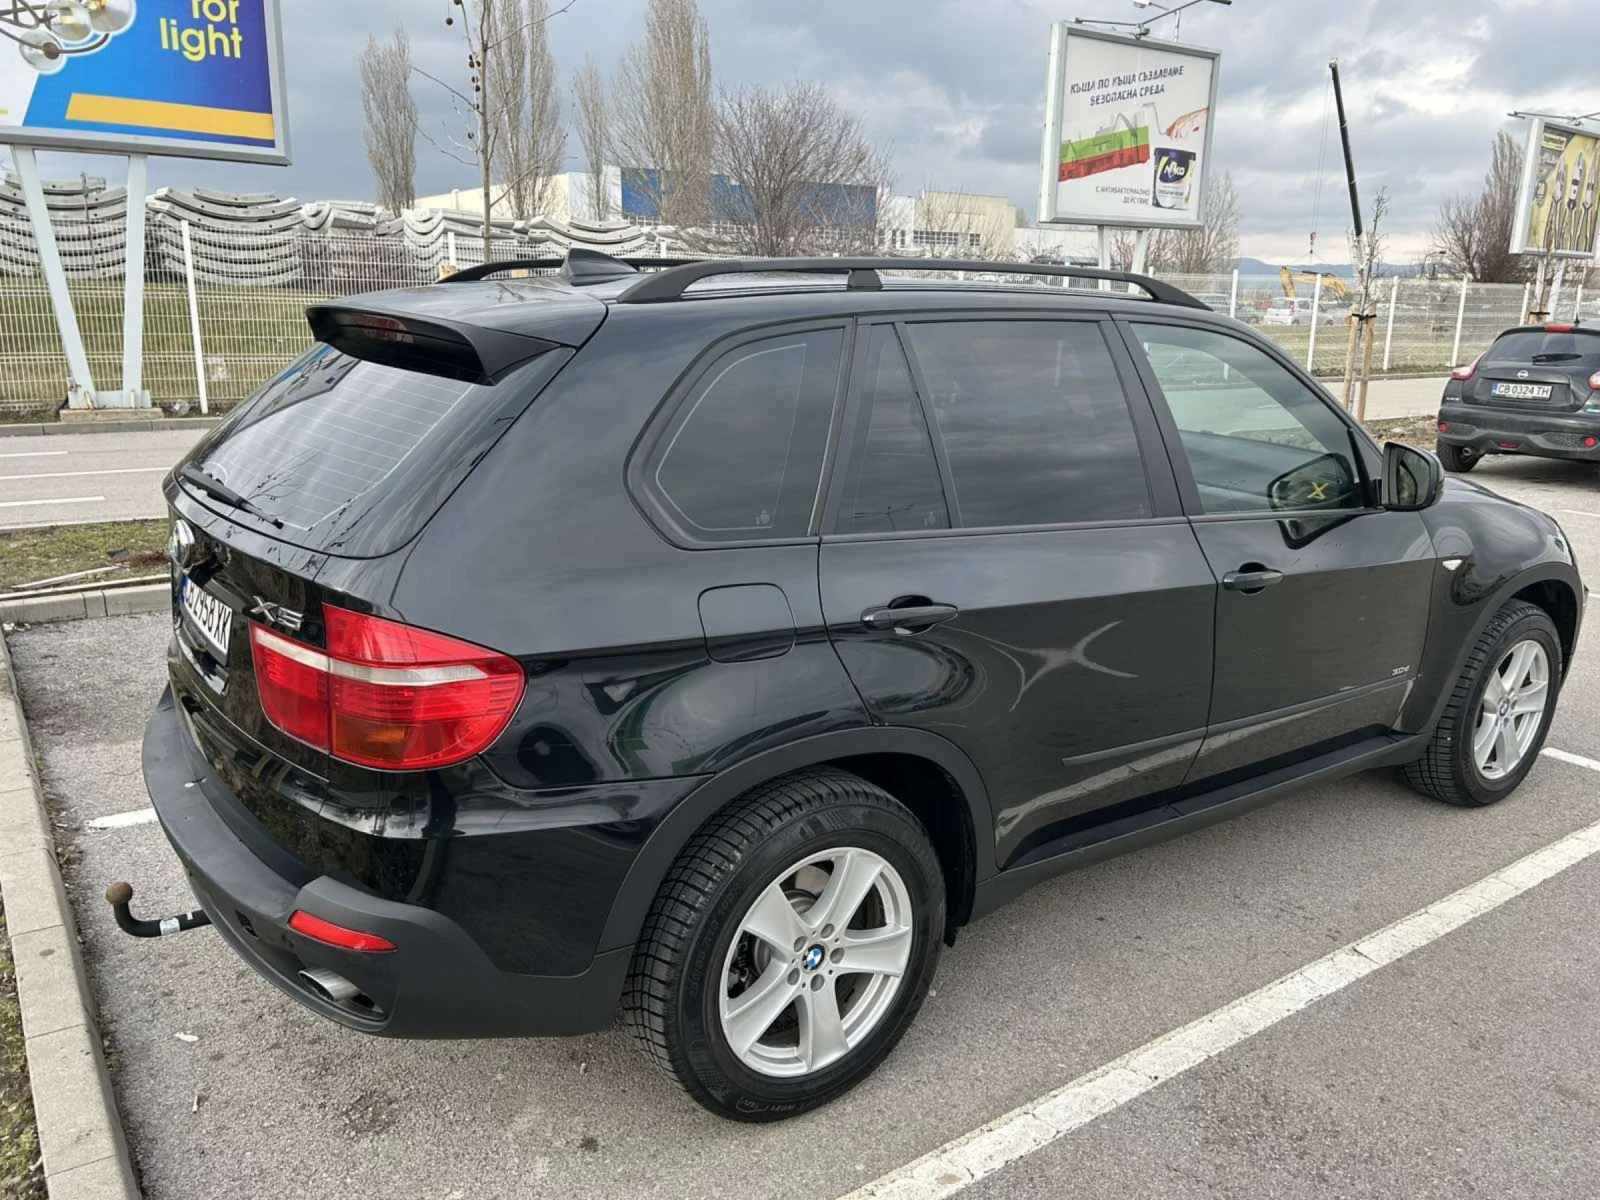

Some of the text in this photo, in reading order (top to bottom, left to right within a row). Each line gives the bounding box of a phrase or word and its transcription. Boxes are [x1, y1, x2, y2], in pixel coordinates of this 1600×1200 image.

[160, 17, 242, 62] light
[1070, 65, 1185, 95] КЪЩА ПО КЪЩА СЪЗДАВАМЕ
[1090, 84, 1165, 106] БЕЗОПАСНА СРЕДА
[1511, 385, 1534, 395] 0324
[1536, 386, 1549, 396] TH
[250, 596, 304, 631] X5
